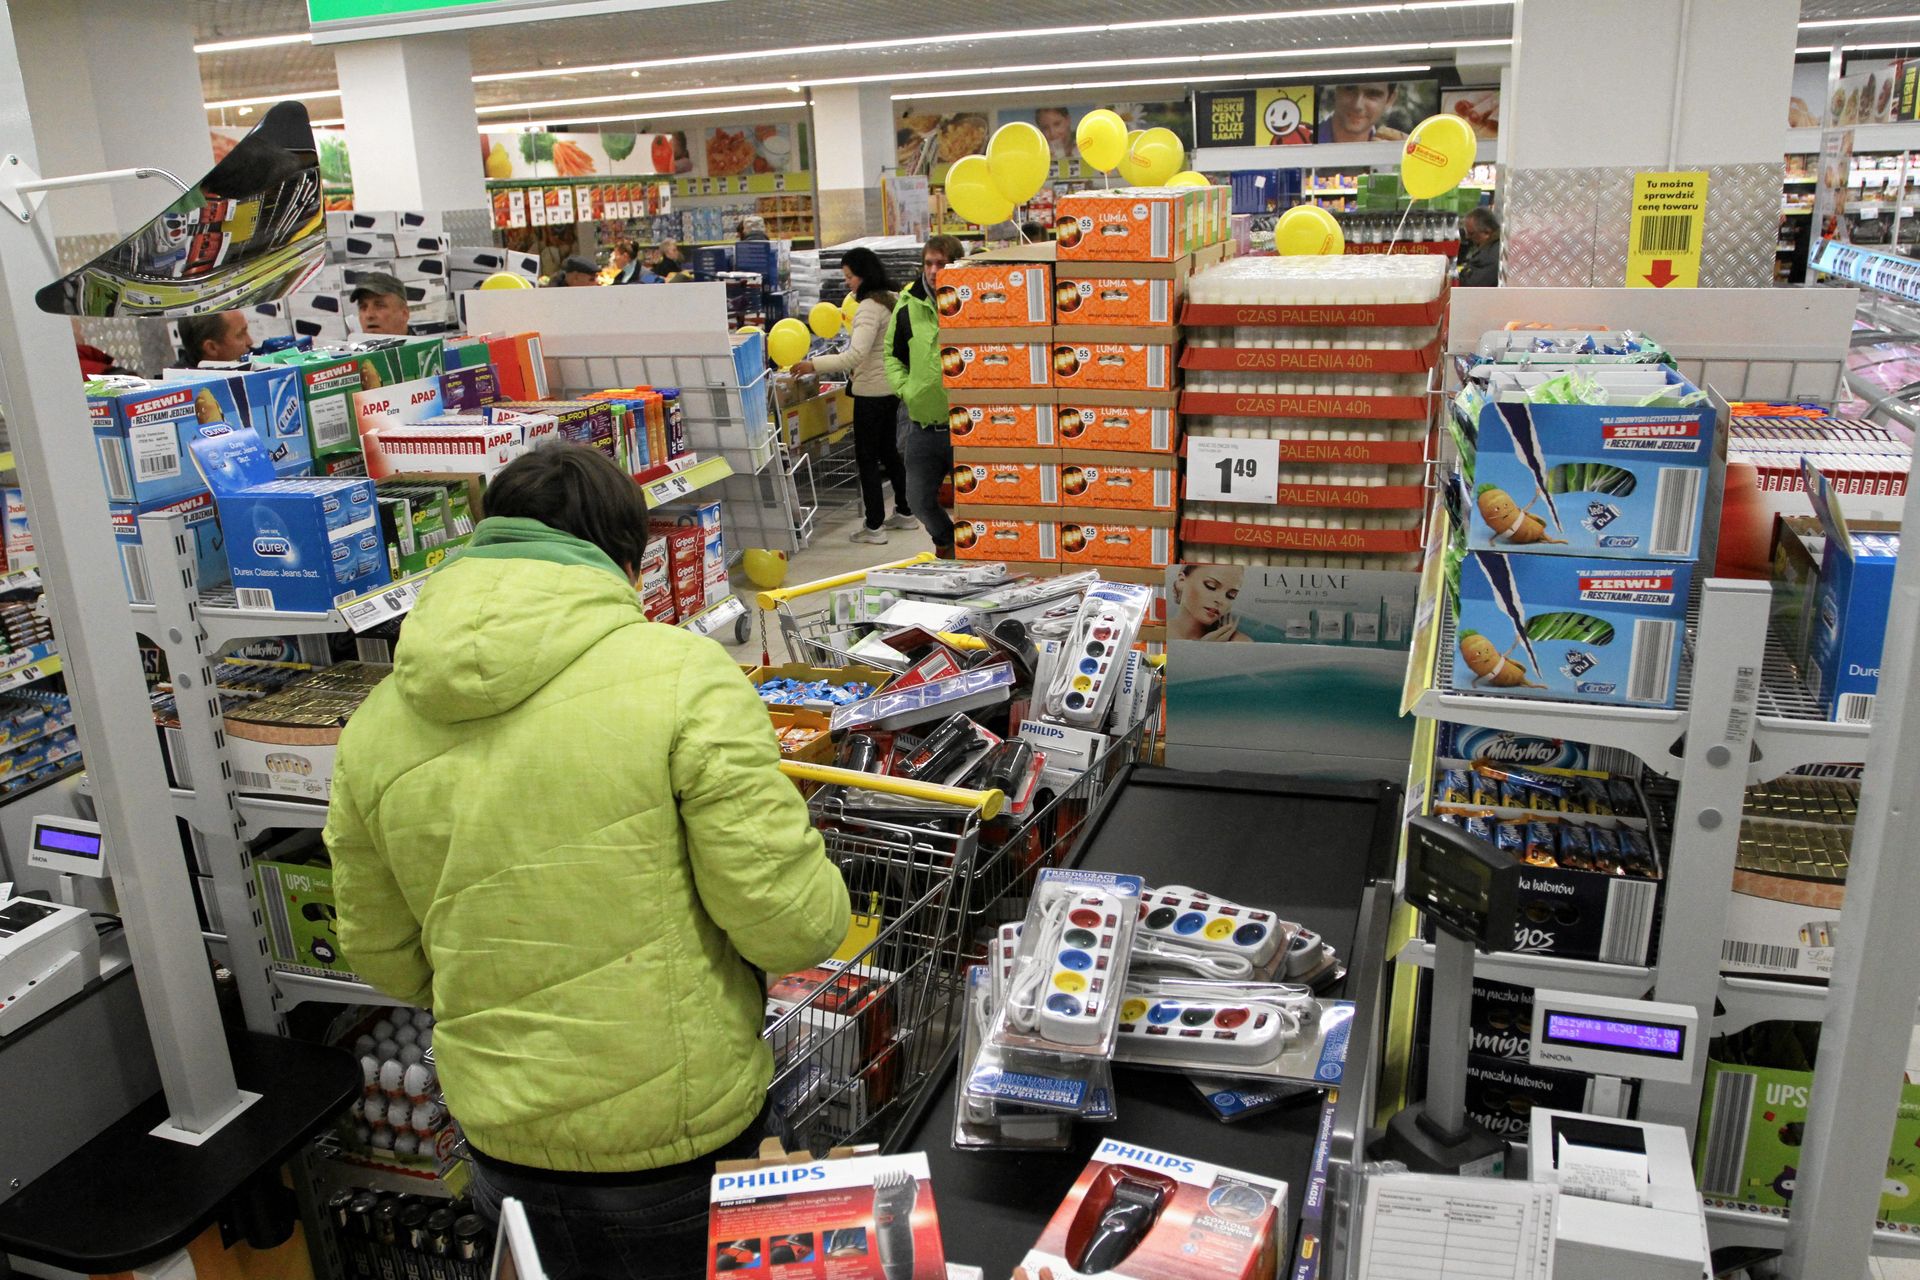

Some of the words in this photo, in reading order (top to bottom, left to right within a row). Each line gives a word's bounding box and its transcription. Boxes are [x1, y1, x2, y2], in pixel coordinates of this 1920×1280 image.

[1212, 112, 1244, 123] CENY
[1647, 180, 1657, 188] Tu
[1660, 180, 1694, 188] można
[1644, 190, 1694, 202] sprawdzić
[1638, 204, 1660, 212] cenę
[1663, 203, 1698, 211] towaru
[1362, 245, 1407, 254] PALENIA
[1080, 284, 1091, 292] 55
[1236, 310, 1277, 323] CZAS
[1281, 310, 1345, 323] PALENIA
[1348, 310, 1375, 323] 40h
[962, 350, 973, 358] 55
[1078, 350, 1089, 358] 55
[1236, 353, 1276, 367] CZAS
[1280, 354, 1344, 368] PALENIA
[1346, 355, 1373, 369] 40h
[313, 364, 352, 382] ZERWIJ
[135, 392, 186, 414] ZERWIJ
[411, 389, 436, 405] APAP
[362, 401, 389, 416] APAP
[1235, 398, 1275, 412] CZAS
[1279, 399, 1342, 413] PALENIA
[1345, 400, 1372, 414] 40h
[1084, 412, 1094, 420] 55
[529, 422, 554, 438] APAP
[1614, 425, 1687, 436] ZERWIJ
[488, 432, 513, 448] APAP
[1610, 439, 1658, 449] RESZTKAMI
[1658, 440, 1696, 450] JEDZENIA
[1280, 444, 1341, 458] PALENIA
[1344, 446, 1370, 459] 40h
[976, 468, 986, 476] 55
[1086, 470, 1097, 478] 55
[1279, 488, 1340, 503] PALENIA
[1343, 491, 1369, 504] 40h
[412, 510, 427, 525] GP
[1085, 528, 1096, 536] 55
[1234, 527, 1273, 543] CZAS
[1276, 531, 1337, 547] PALENIA
[1339, 534, 1365, 548] 40h
[256, 538, 288, 554] durex
[426, 549, 445, 568] GP
[234, 567, 254, 576] Durex
[254, 568, 280, 577] Classic
[281, 569, 301, 578] Jeans
[1264, 573, 1287, 587] LA
[1590, 579, 1661, 589] ZERWIJ
[1285, 589, 1328, 597] PARIS
[1587, 591, 1633, 601] RESZTKAMI
[1633, 593, 1670, 603] JEDZENIA
[1123, 651, 1137, 694] PHILIPS
[1849, 664, 1880, 677] Dure
[1021, 724, 1065, 739] PHILIPS
[285, 873, 312, 892] UPS!
[1532, 878, 1575, 896] batonów
[1551, 1015, 1601, 1031] Maszynka
[1645, 1026, 1678, 1039] 40.00
[1470, 1027, 1531, 1058] migo
[1480, 1067, 1512, 1083] paczka
[1513, 1073, 1554, 1091] batonów
[1765, 1083, 1809, 1109] UPS
[1101, 1141, 1196, 1174] PHILIPS
[718, 1166, 826, 1191] PHILIPS
[1197, 1218, 1253, 1238] FOLLOWING
[1203, 1215, 1251, 1232] CONTOUR
